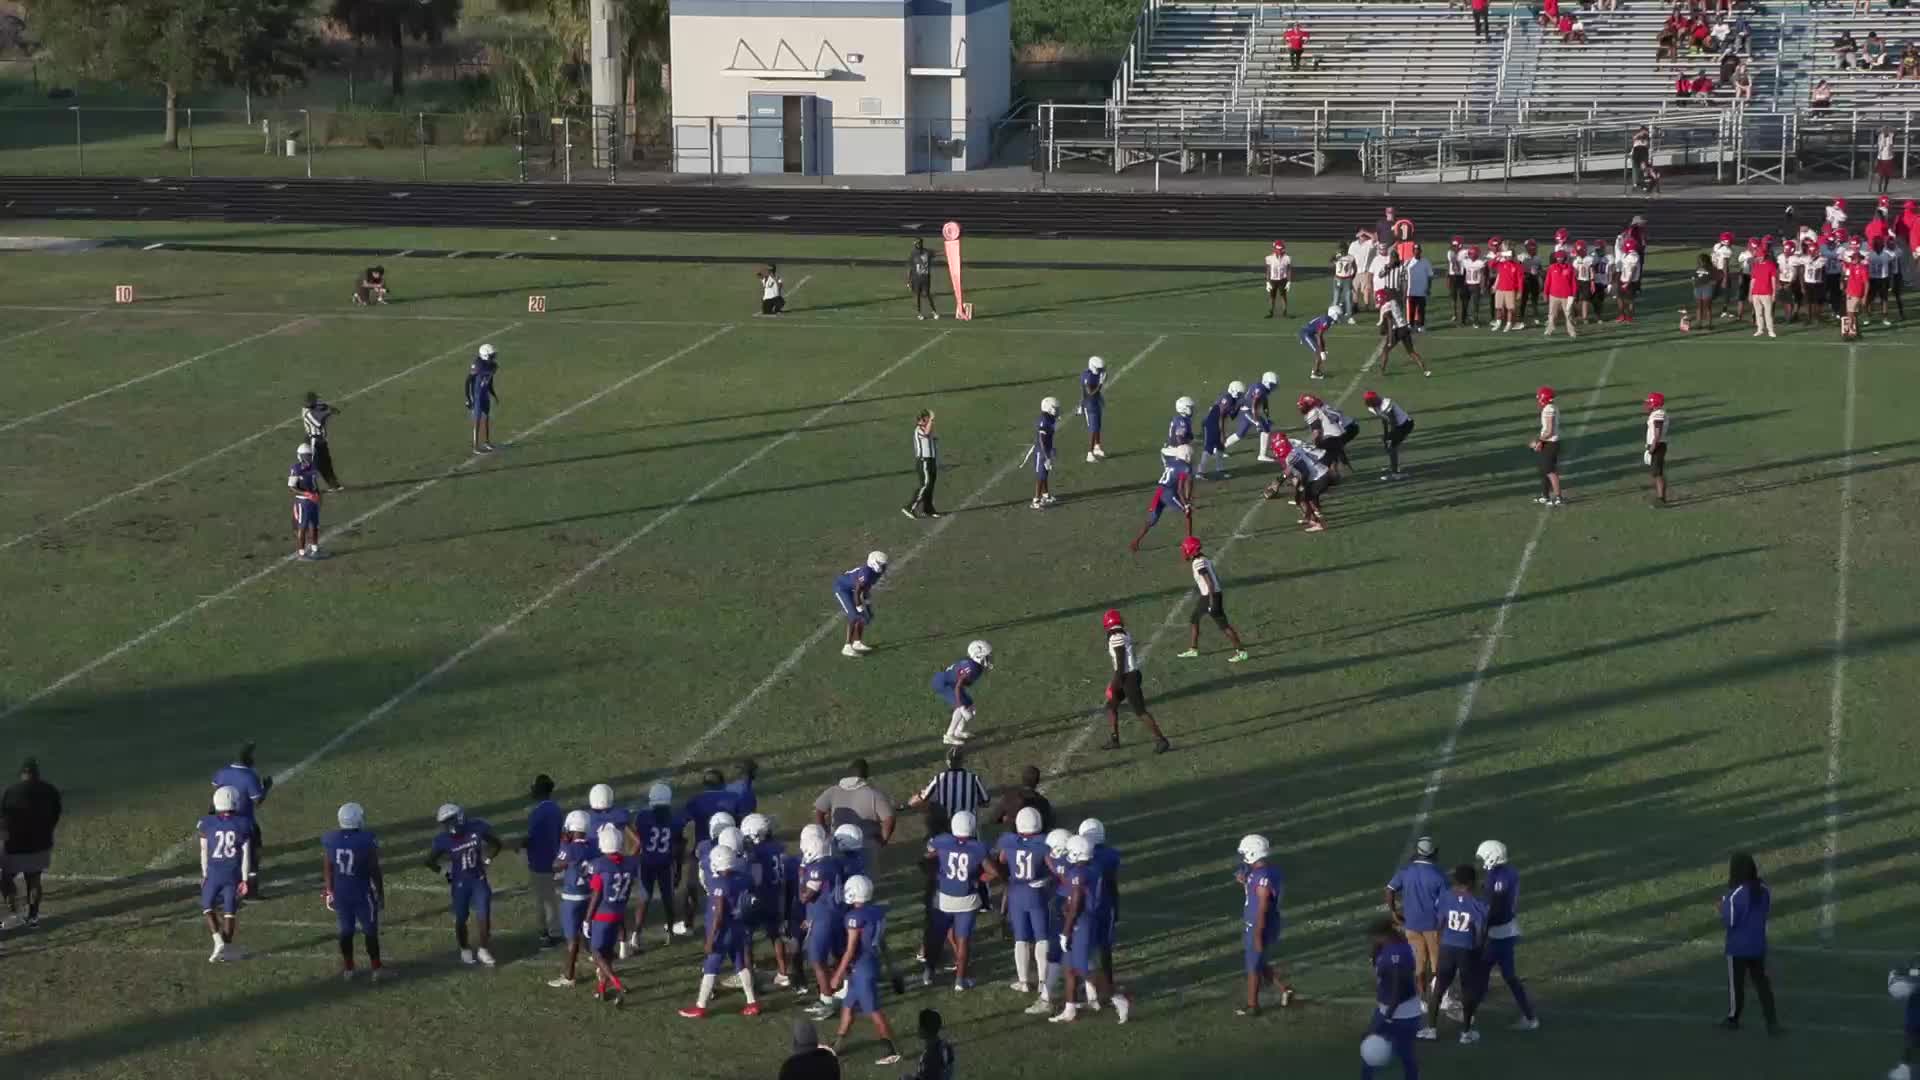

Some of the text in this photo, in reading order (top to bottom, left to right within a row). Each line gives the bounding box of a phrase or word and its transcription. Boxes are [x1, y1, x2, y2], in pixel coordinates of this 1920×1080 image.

[118, 287, 131, 301] 10
[530, 297, 545, 311] 20
[212, 830, 236, 858] 28
[646, 826, 671, 853] 33
[946, 852, 969, 881] 58
[1015, 849, 1033, 880] 51
[1448, 909, 1470, 932] 82
